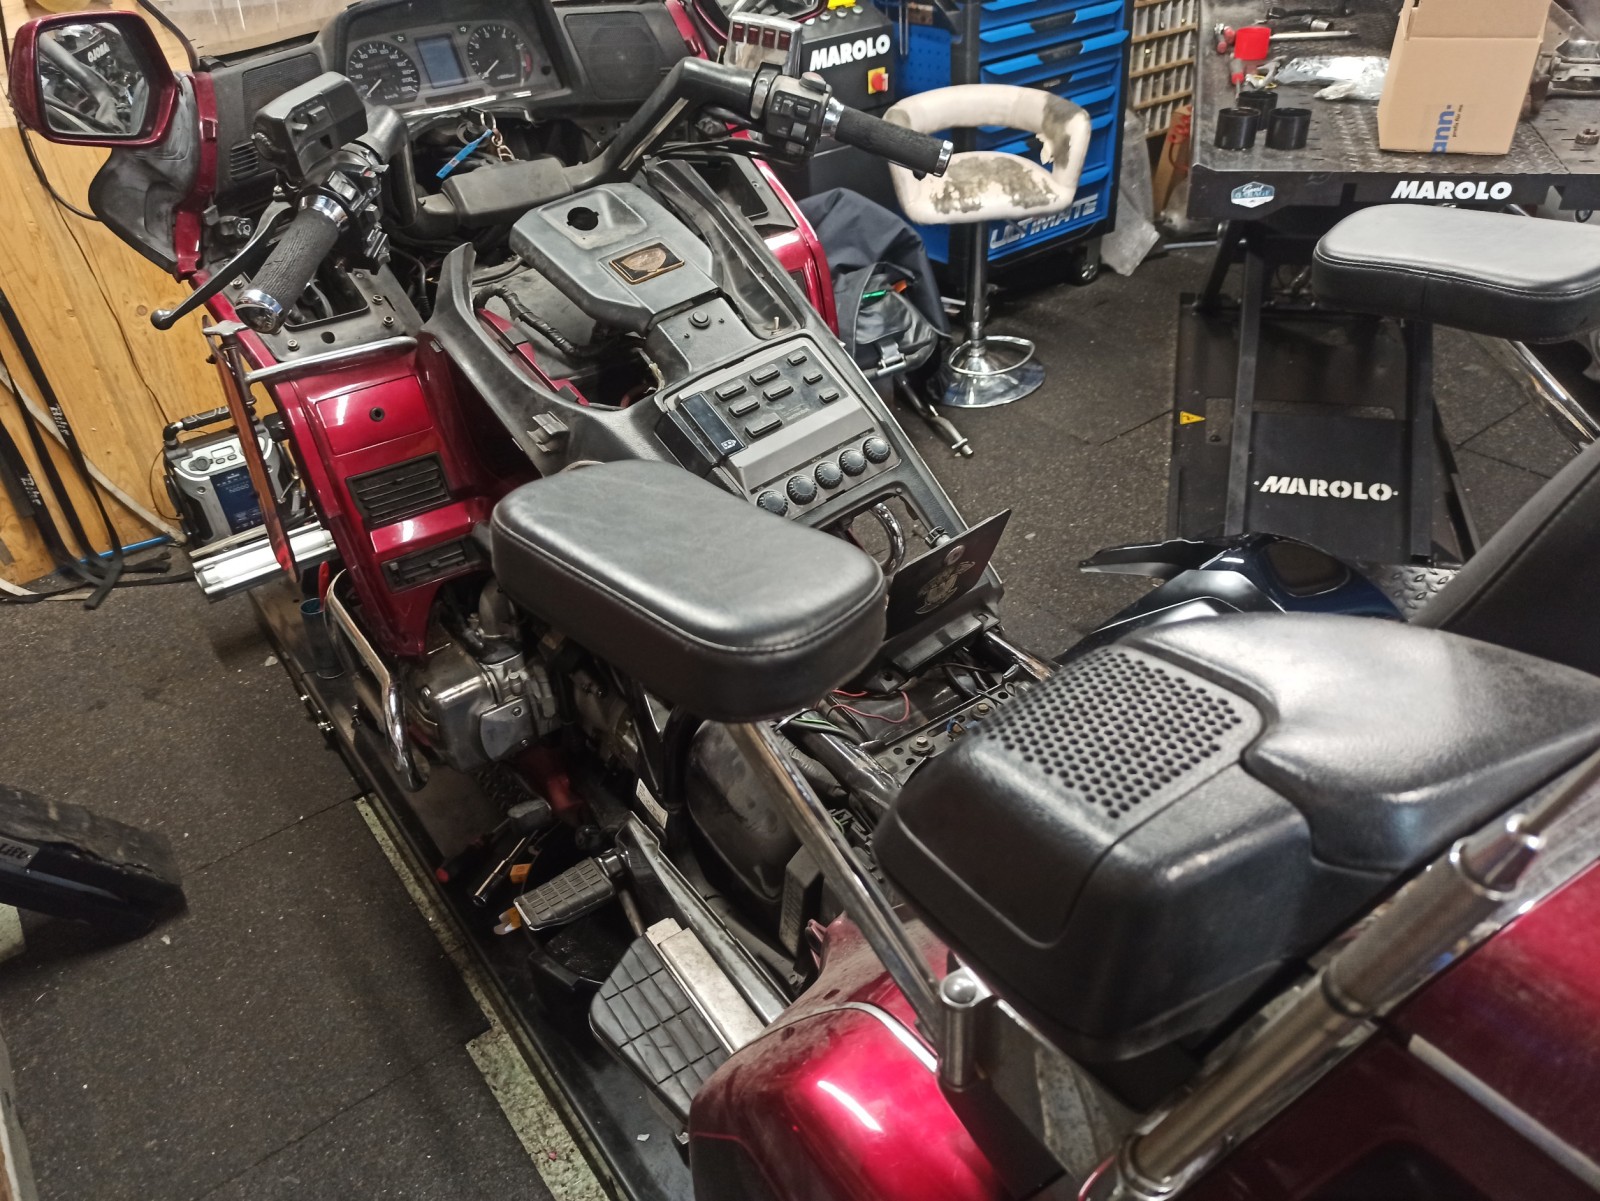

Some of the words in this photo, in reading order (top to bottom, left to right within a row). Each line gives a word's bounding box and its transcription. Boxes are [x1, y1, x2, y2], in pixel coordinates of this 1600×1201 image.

[809, 34, 891, 72] MAROLO
[1390, 180, 1513, 200] MAROLO
[989, 193, 1099, 249] ULTIMATE
[1259, 475, 1393, 501] MAROLO
